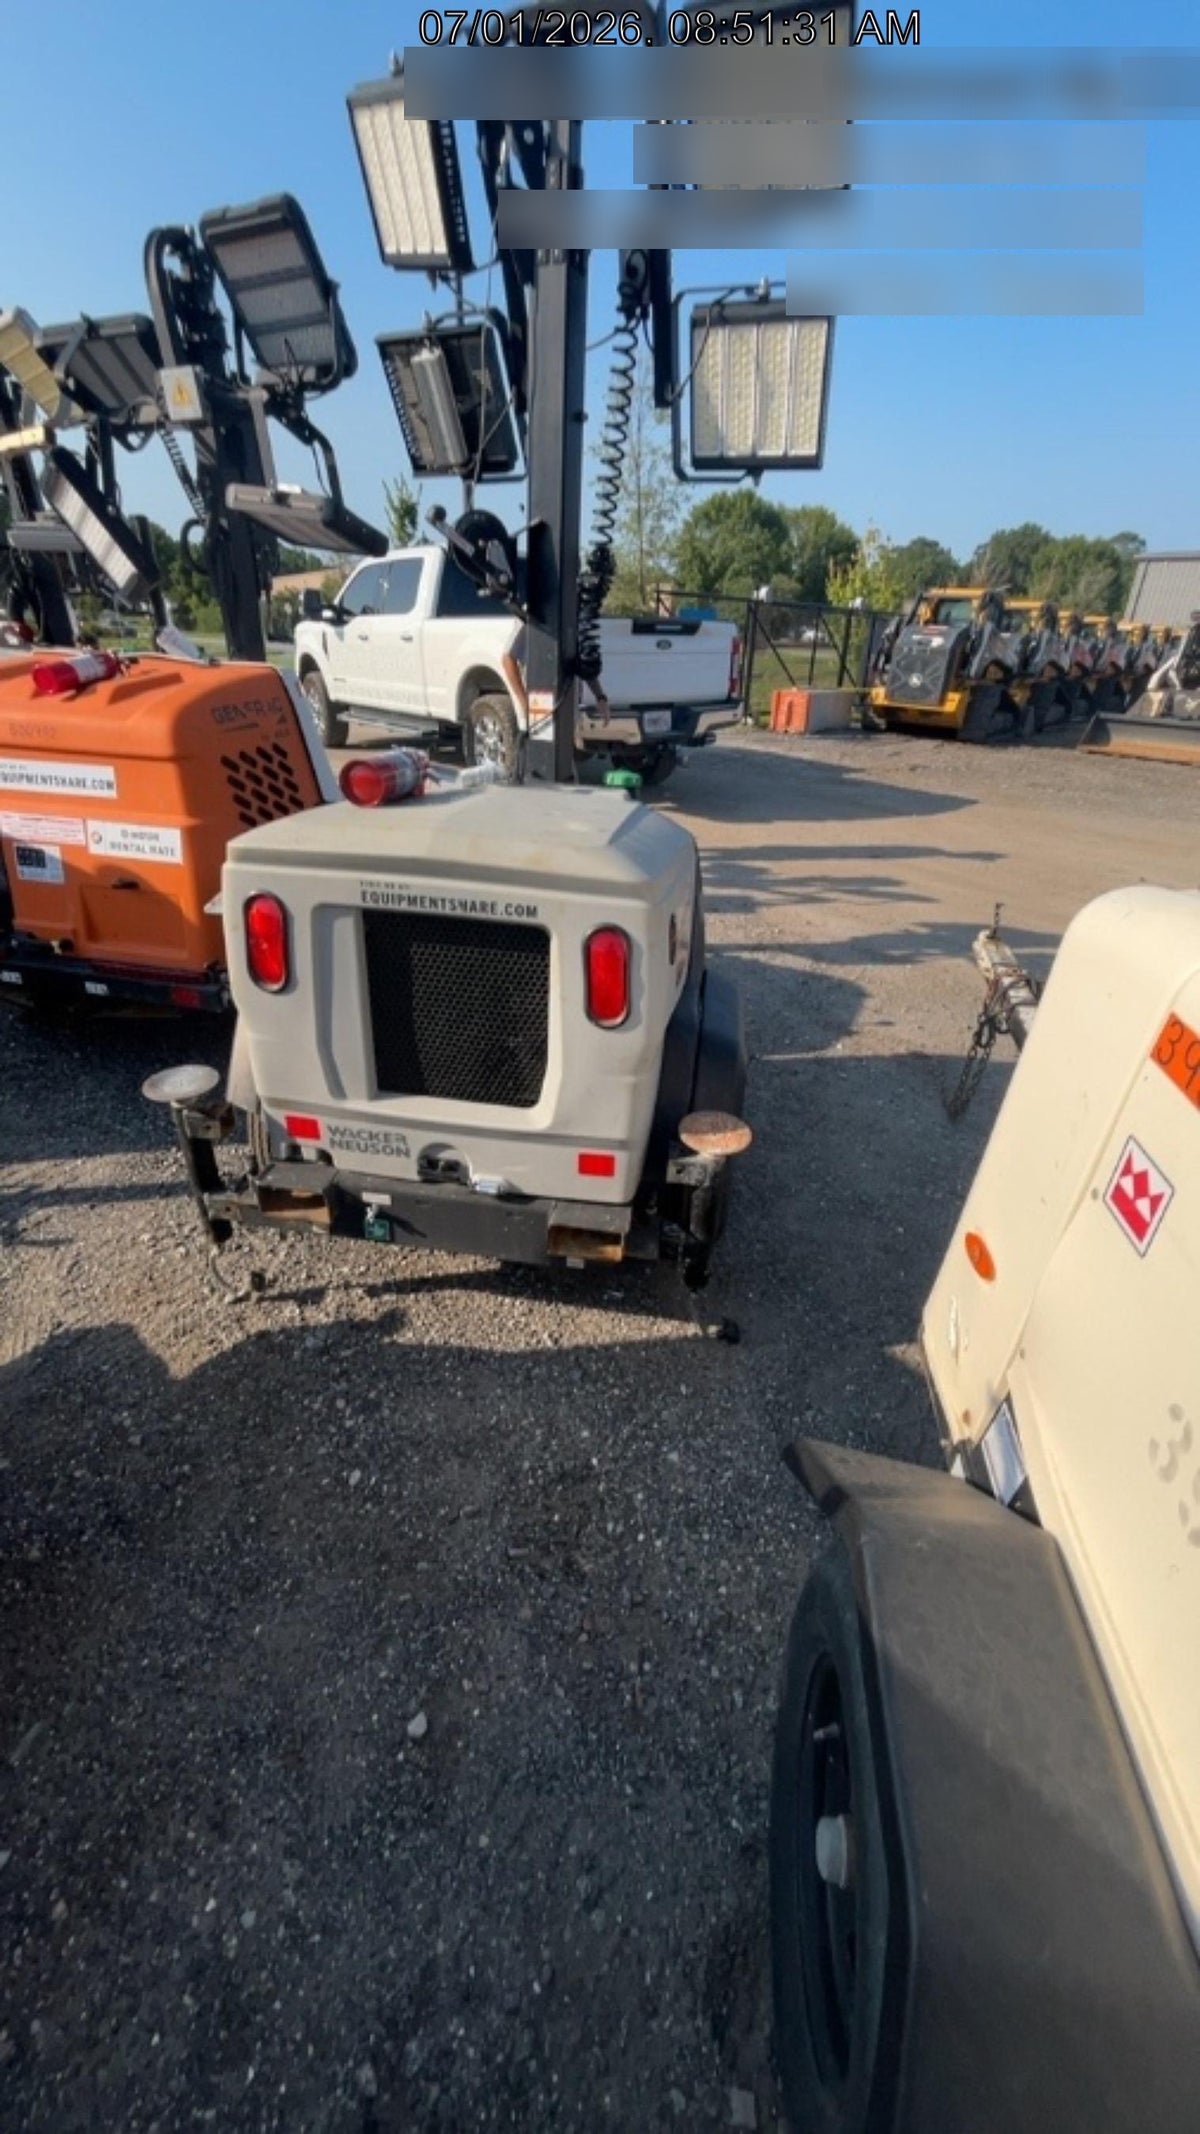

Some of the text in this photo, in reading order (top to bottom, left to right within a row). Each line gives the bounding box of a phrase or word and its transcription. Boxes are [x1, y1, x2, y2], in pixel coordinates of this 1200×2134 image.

[1157, 1021, 1200, 1106] 39
[327, 1125, 408, 1146] WACKER
[329, 1137, 411, 1158] NEUSON
